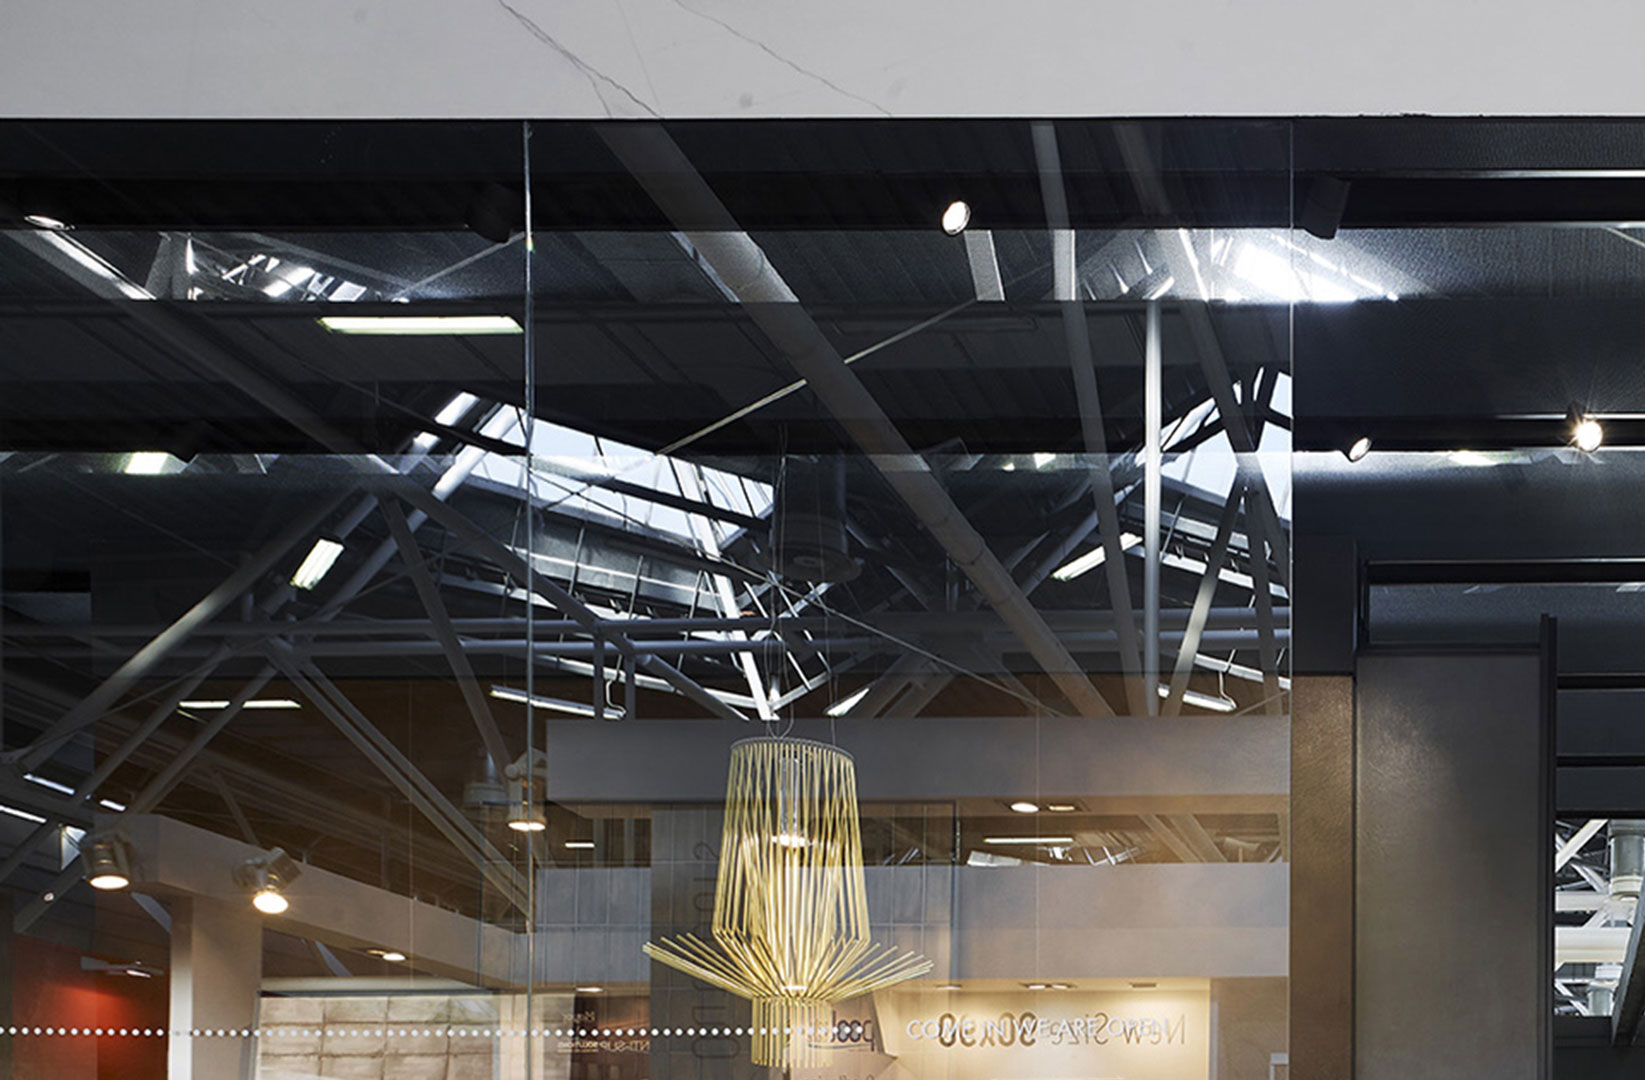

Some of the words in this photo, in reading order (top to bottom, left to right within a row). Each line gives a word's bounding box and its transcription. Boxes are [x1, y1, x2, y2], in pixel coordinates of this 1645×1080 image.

[906, 1018, 976, 1040] COME
[981, 1018, 1005, 1040] IN
[1012, 1018, 1050, 1038] WE
[1057, 1018, 1100, 1037] ARE
[1106, 1017, 1168, 1036] OPEN
